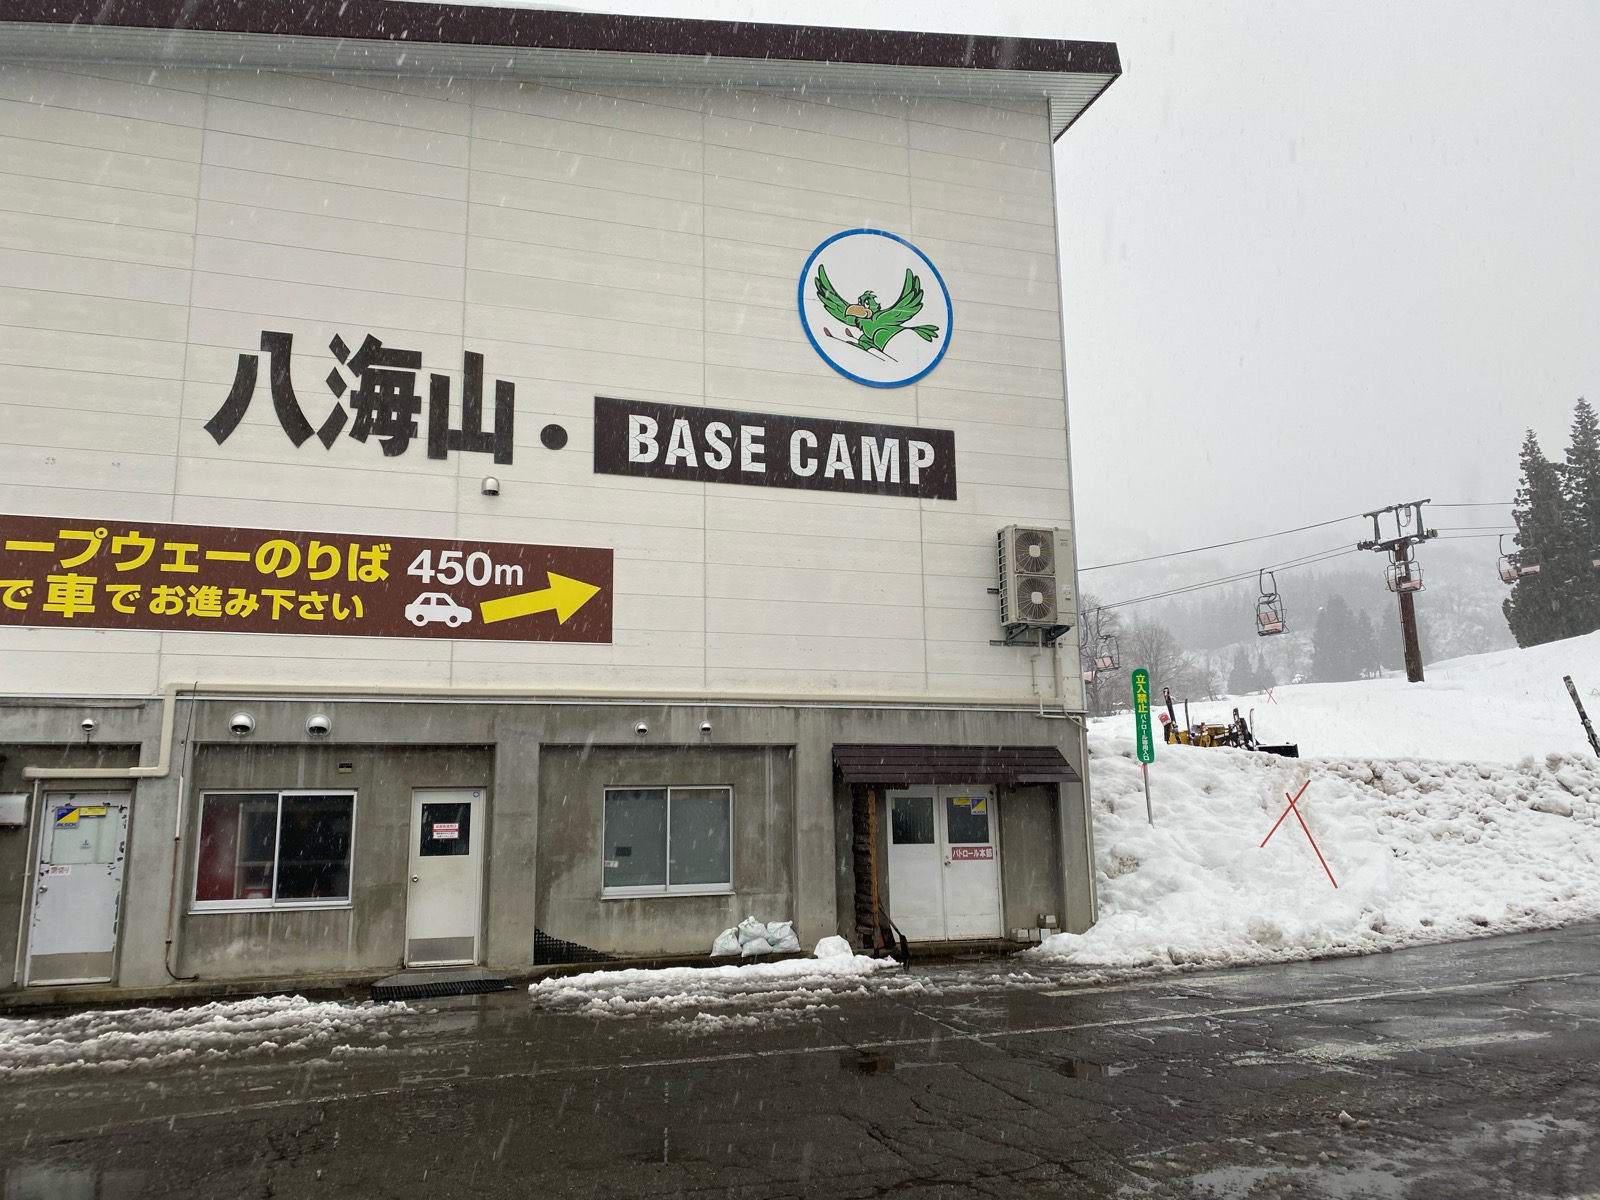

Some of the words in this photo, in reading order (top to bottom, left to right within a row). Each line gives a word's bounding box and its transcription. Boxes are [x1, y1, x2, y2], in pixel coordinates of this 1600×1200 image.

[628, 414, 767, 474] BASE
[789, 429, 936, 486] CAMP
[407, 549, 524, 587] 450m
[1135, 673, 1148, 713] 立入禁止
[953, 848, 993, 858] パトロール本部
